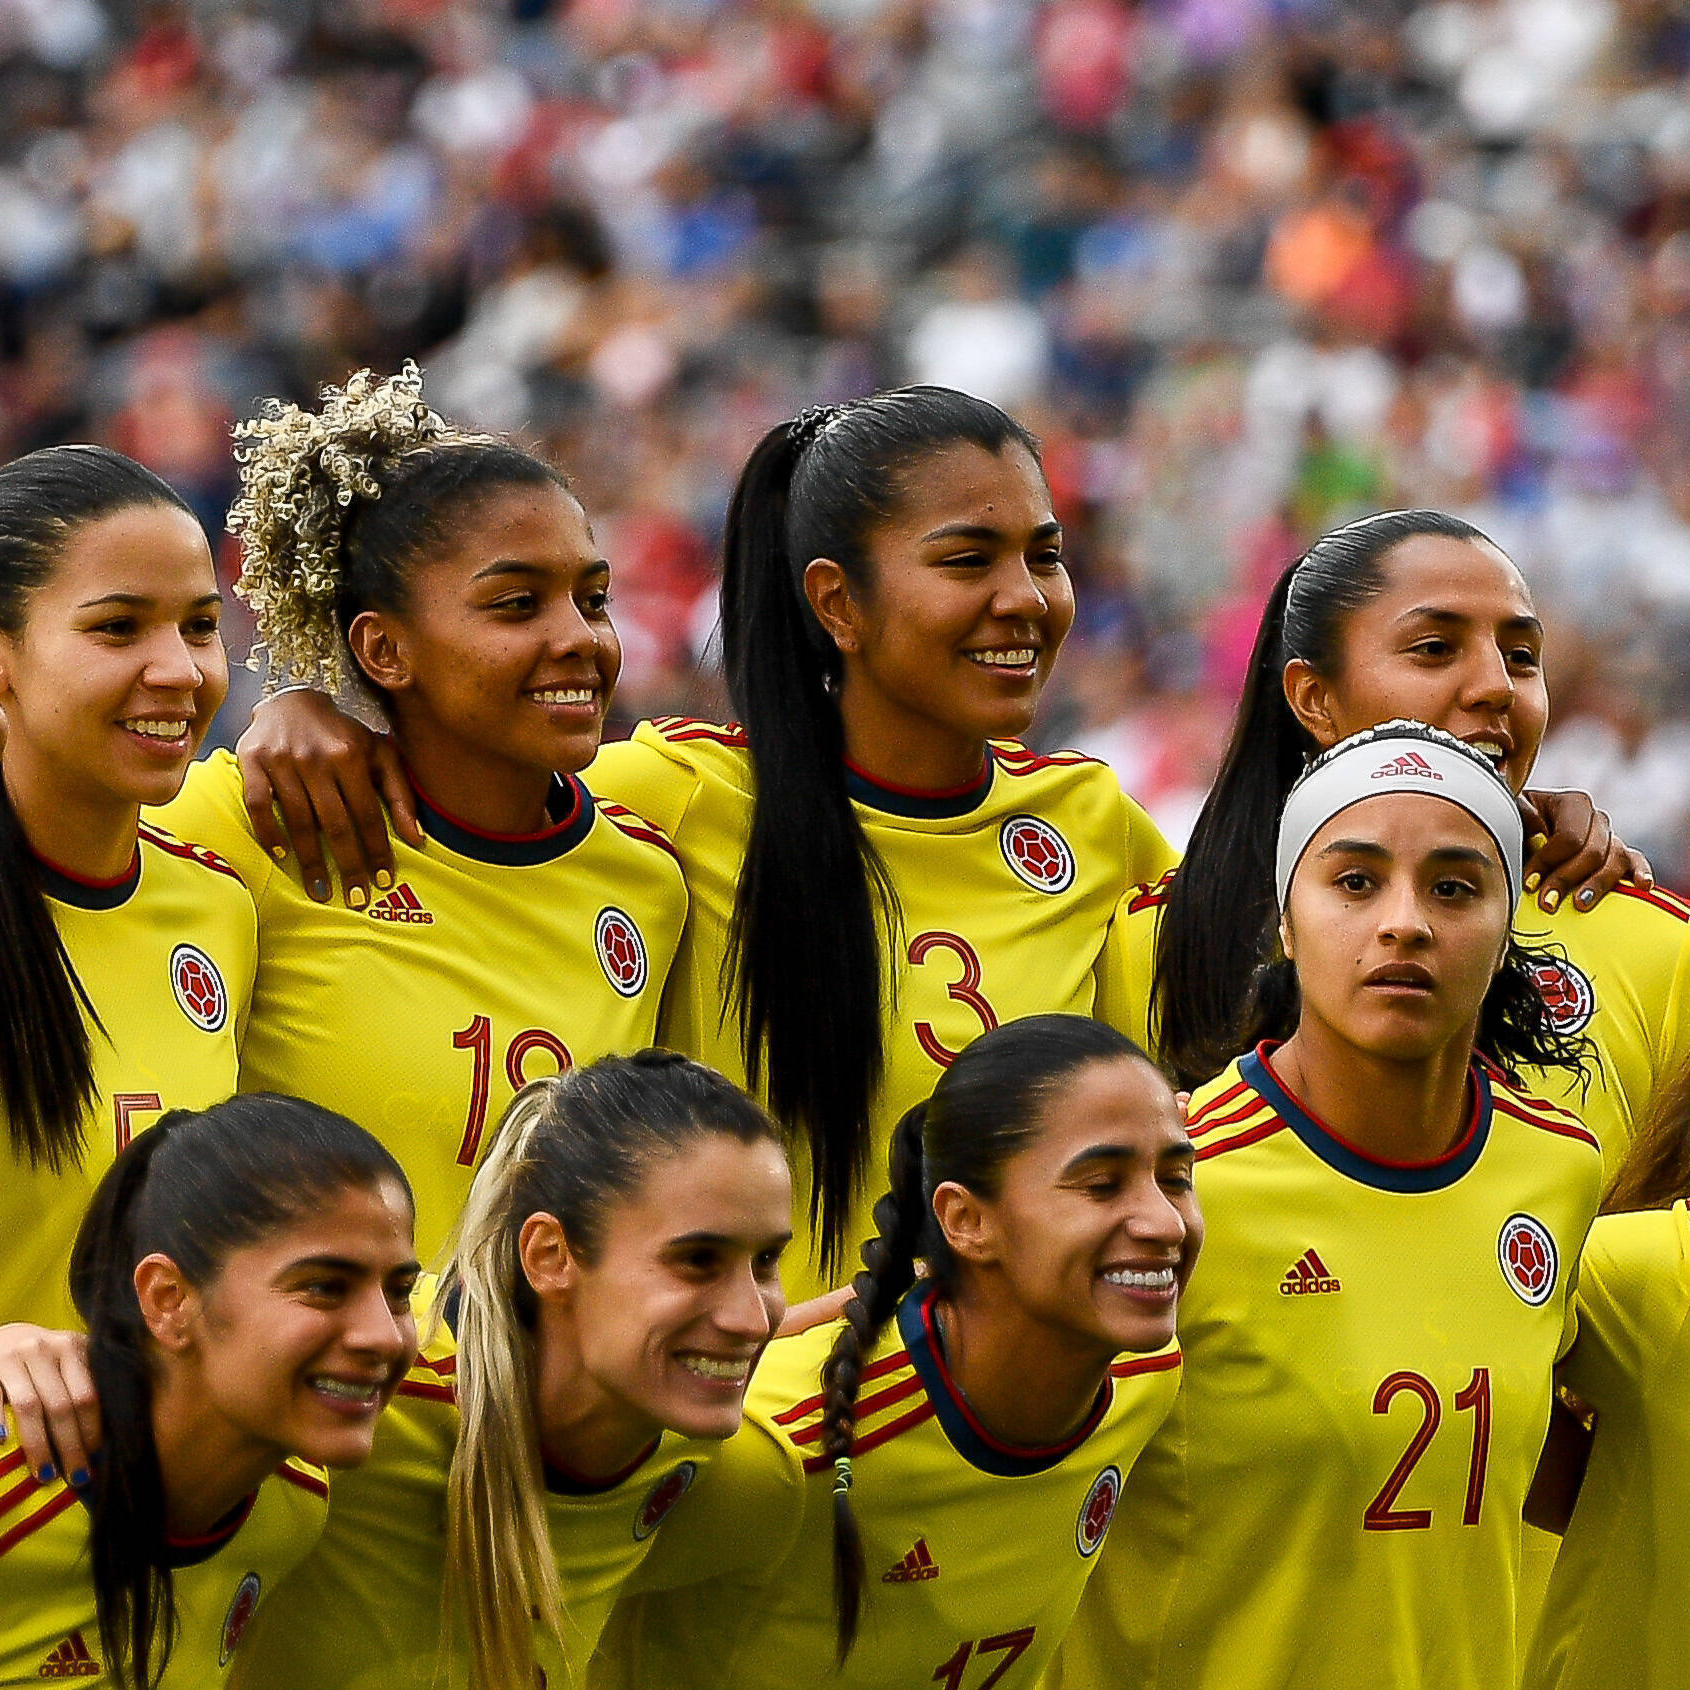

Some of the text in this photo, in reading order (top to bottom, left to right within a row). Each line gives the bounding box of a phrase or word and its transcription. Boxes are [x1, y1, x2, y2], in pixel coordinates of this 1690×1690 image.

[1370, 763, 1443, 782] adidas
[369, 905, 433, 925] adidas
[910, 931, 998, 1068] 3
[1279, 1276, 1340, 1295] adidas
[1363, 1367, 1493, 1532] 21
[38, 1661, 100, 1678] adidas
